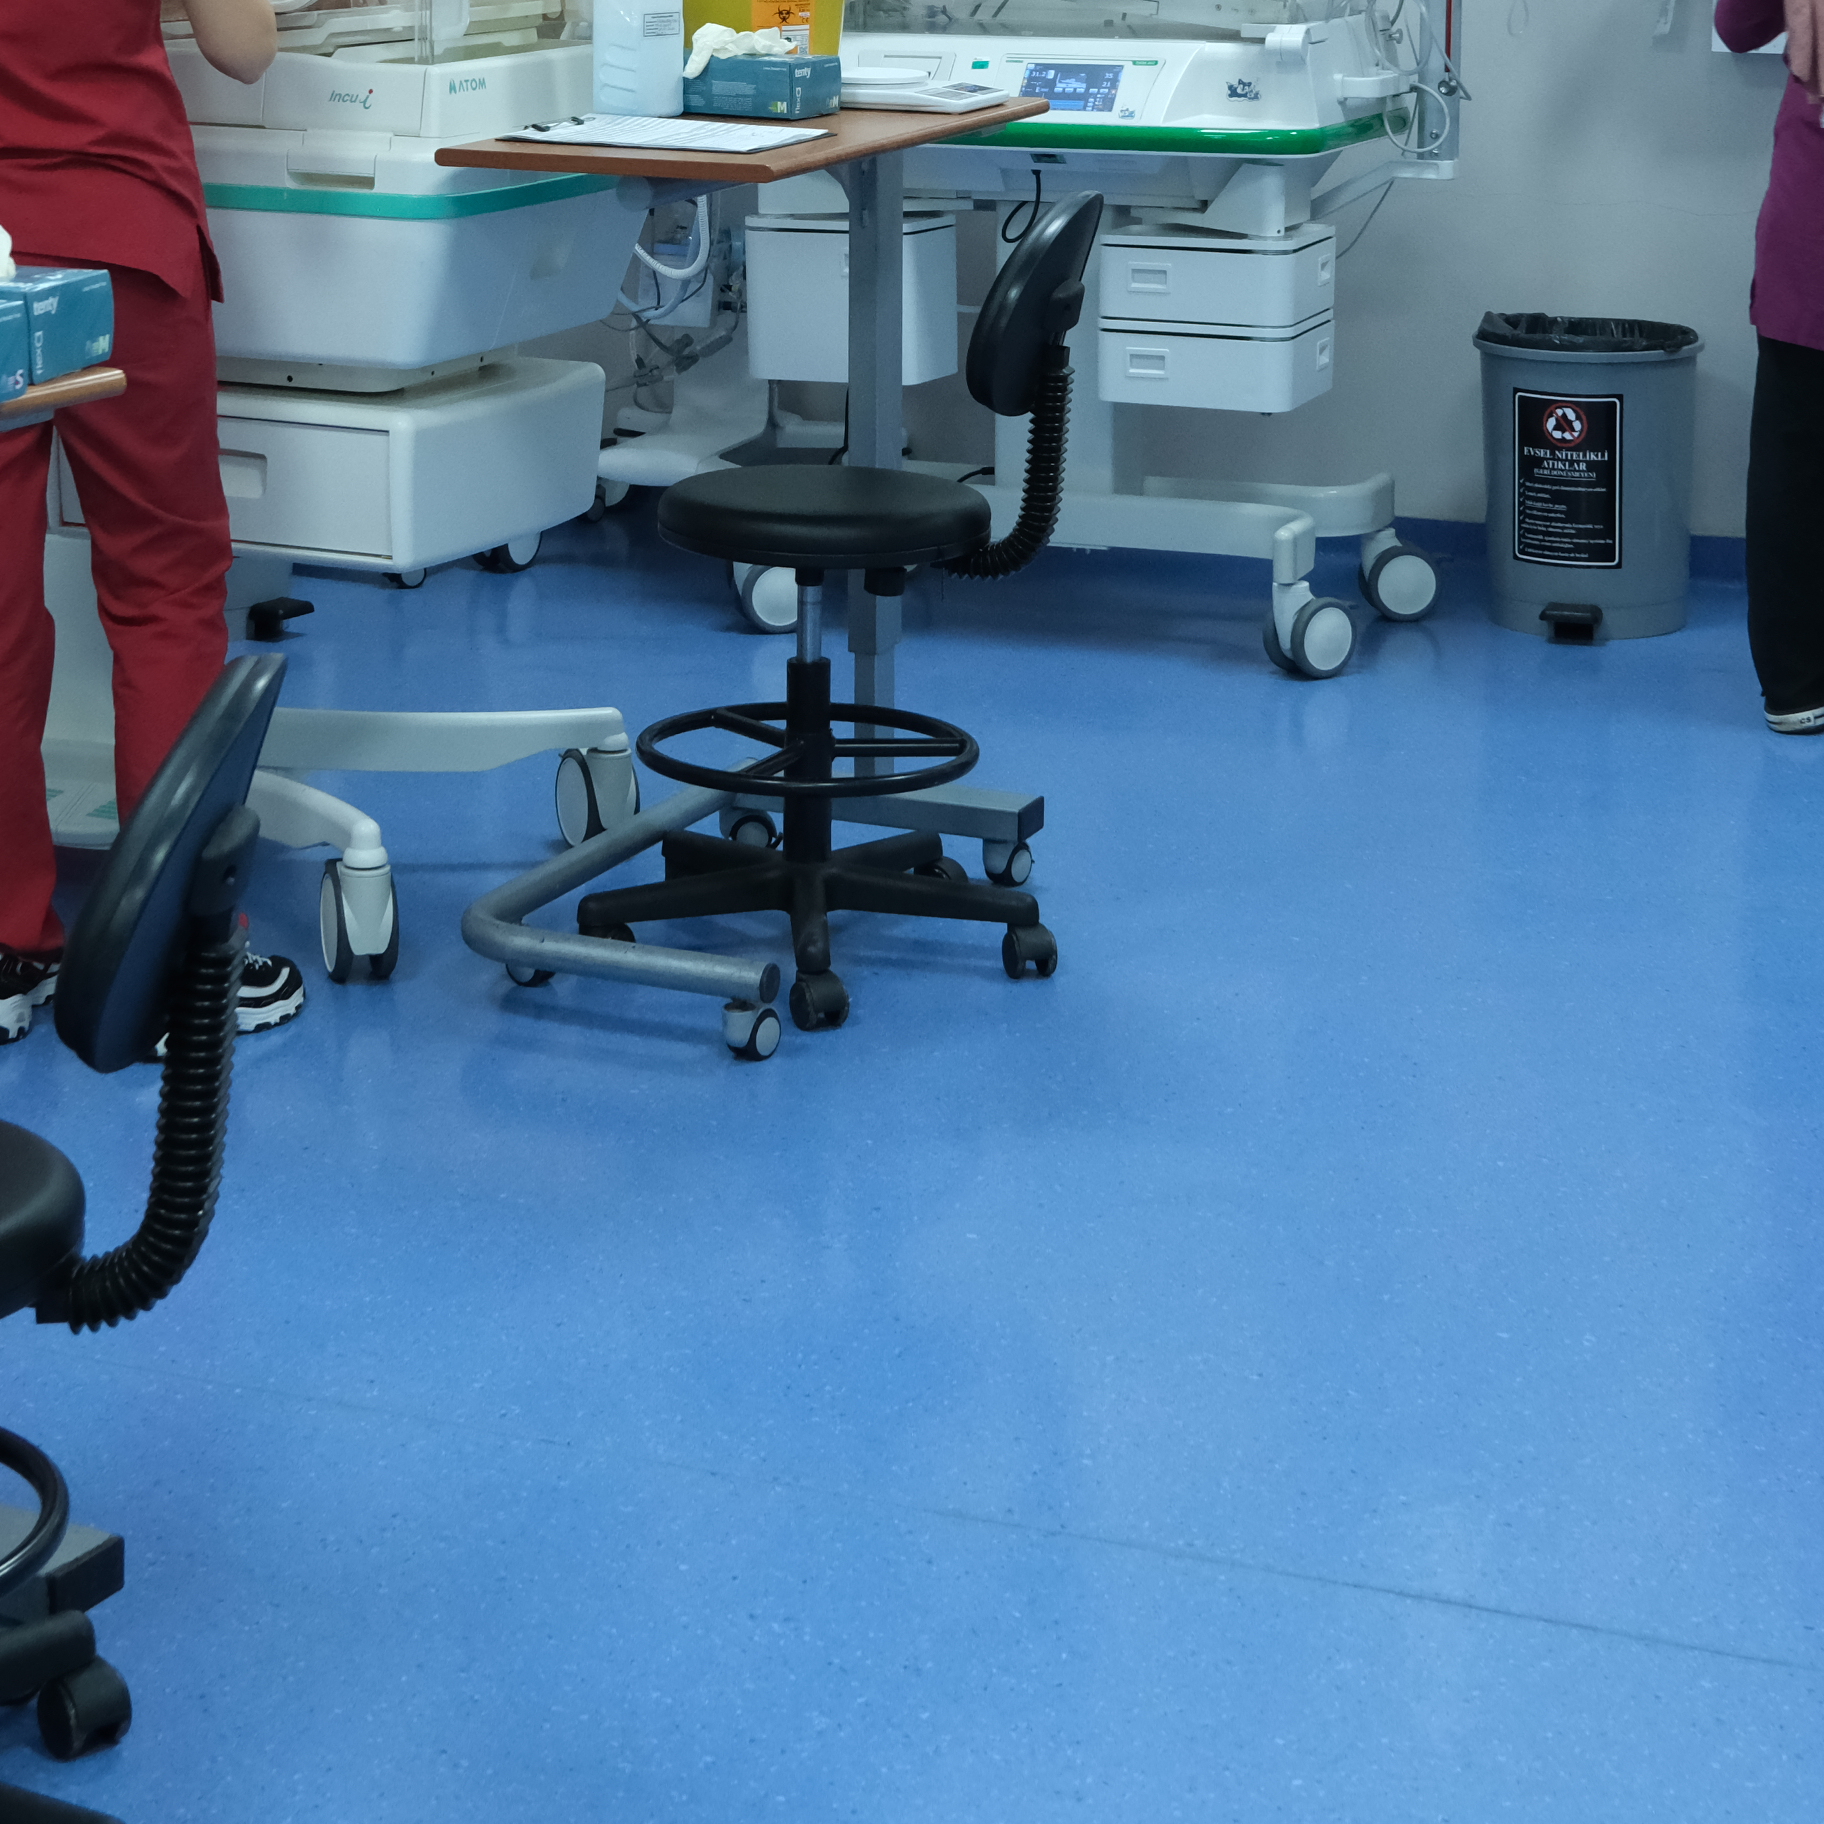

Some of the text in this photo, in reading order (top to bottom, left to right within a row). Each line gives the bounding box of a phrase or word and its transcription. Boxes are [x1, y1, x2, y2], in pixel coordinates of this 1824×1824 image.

[458, 77, 487, 93] ATOM
[33, 295, 60, 316] tenty
[1523, 446, 1609, 461] EVSEL NİTELİKLİ
[1541, 460, 1588, 471] ATIKLAR
